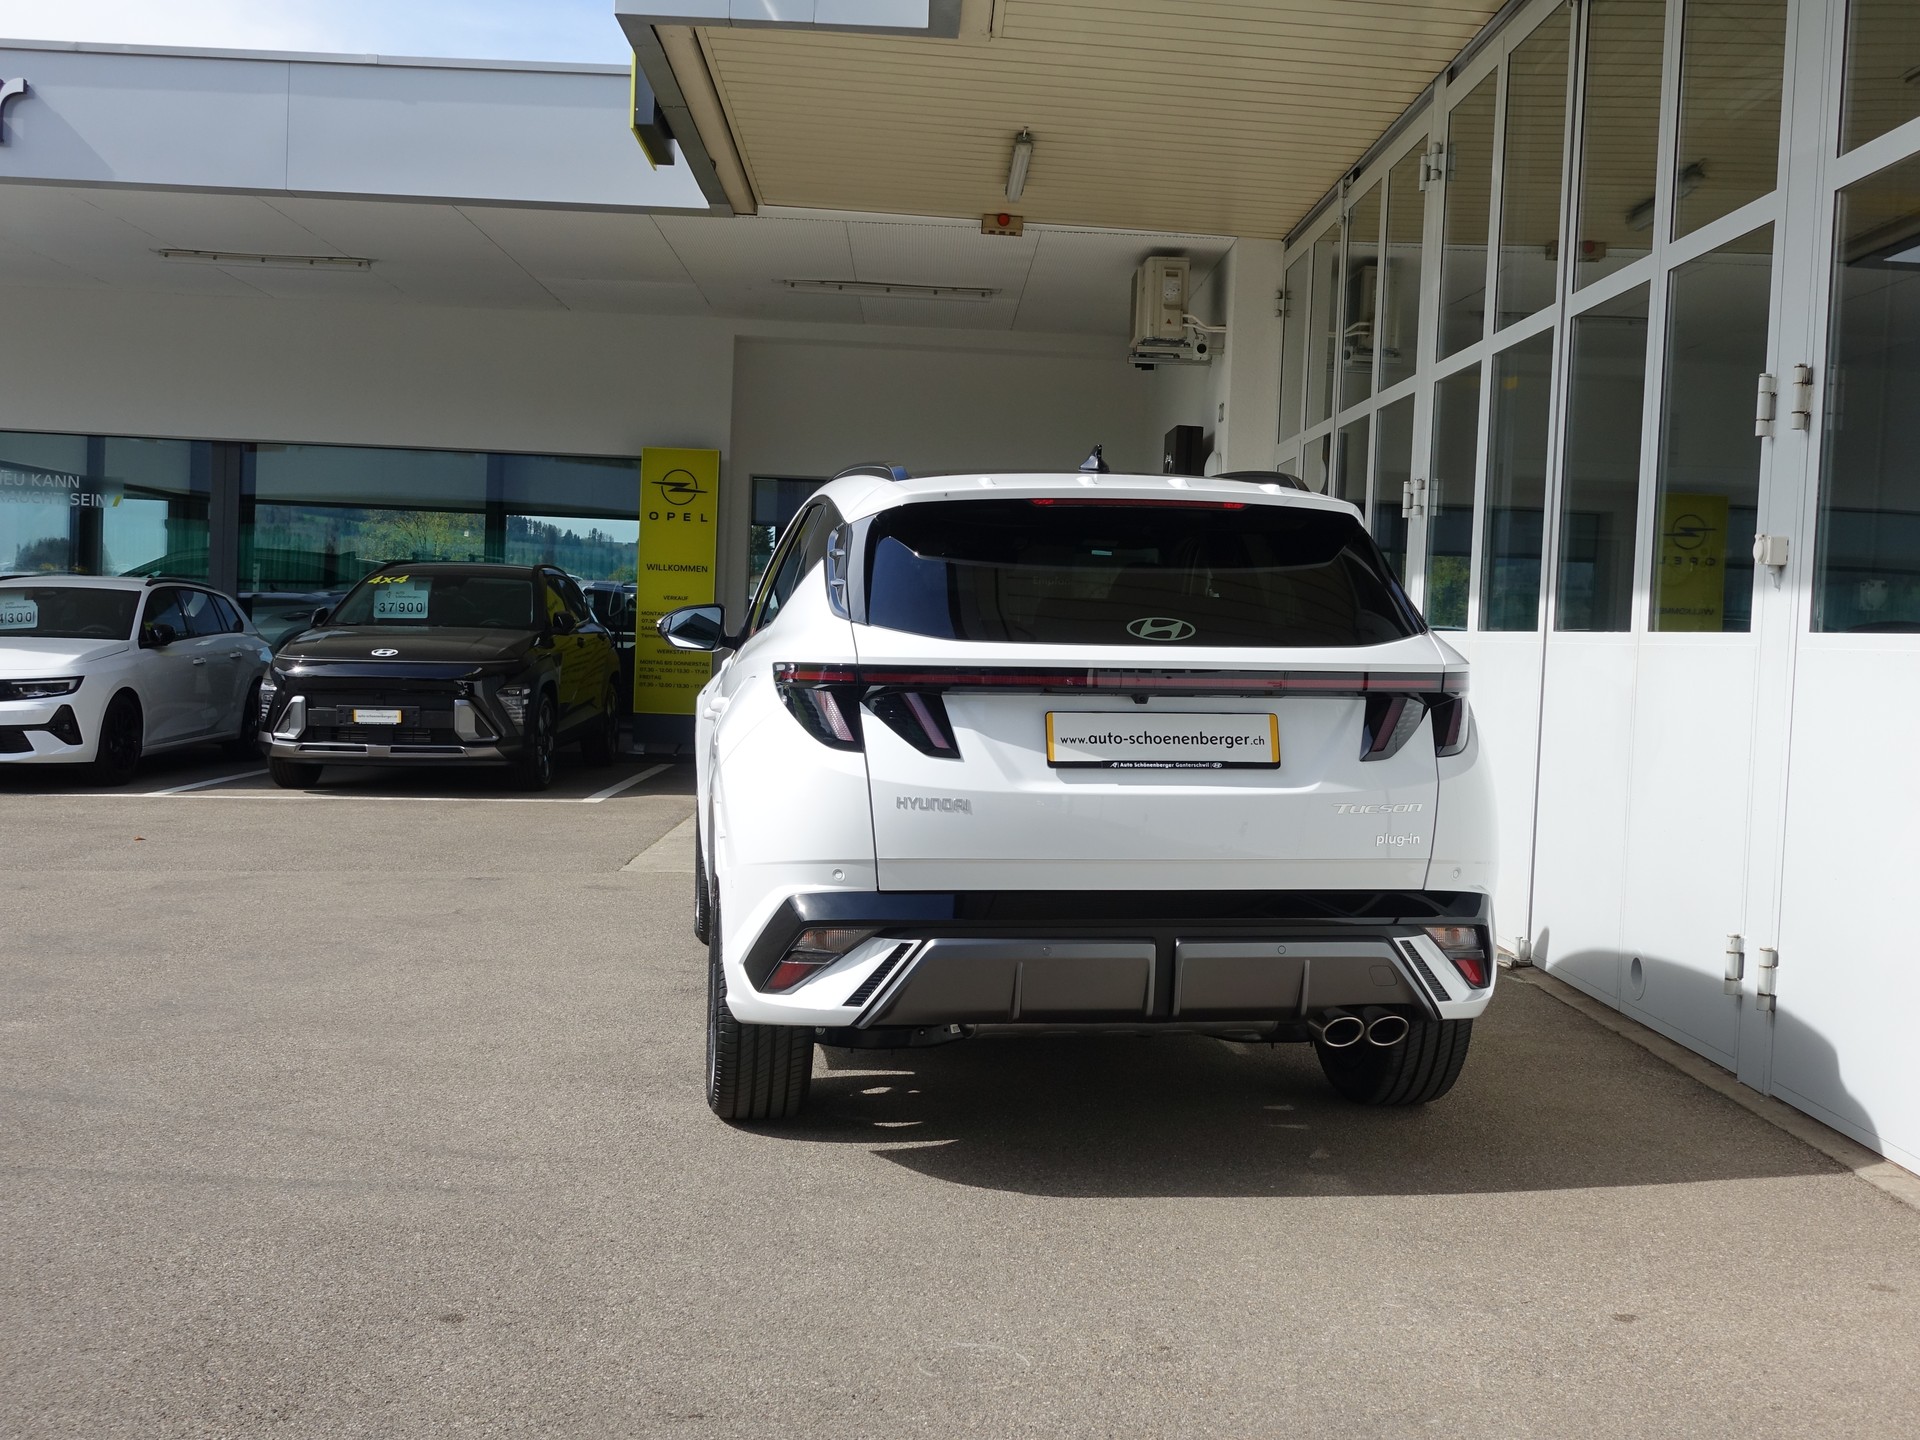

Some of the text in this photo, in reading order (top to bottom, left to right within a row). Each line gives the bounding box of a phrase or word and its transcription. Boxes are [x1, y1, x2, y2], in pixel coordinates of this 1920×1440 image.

[0, 472, 80, 488] EU KANN
[69, 493, 107, 507] SEIN
[649, 511, 708, 523] OPEL
[646, 563, 708, 573] WILLKOMMEN
[1060, 731, 1265, 748] www.auto-schoenenberger.ch
[896, 796, 971, 814] HYUNDAI
[1375, 833, 1420, 847] plug-in
